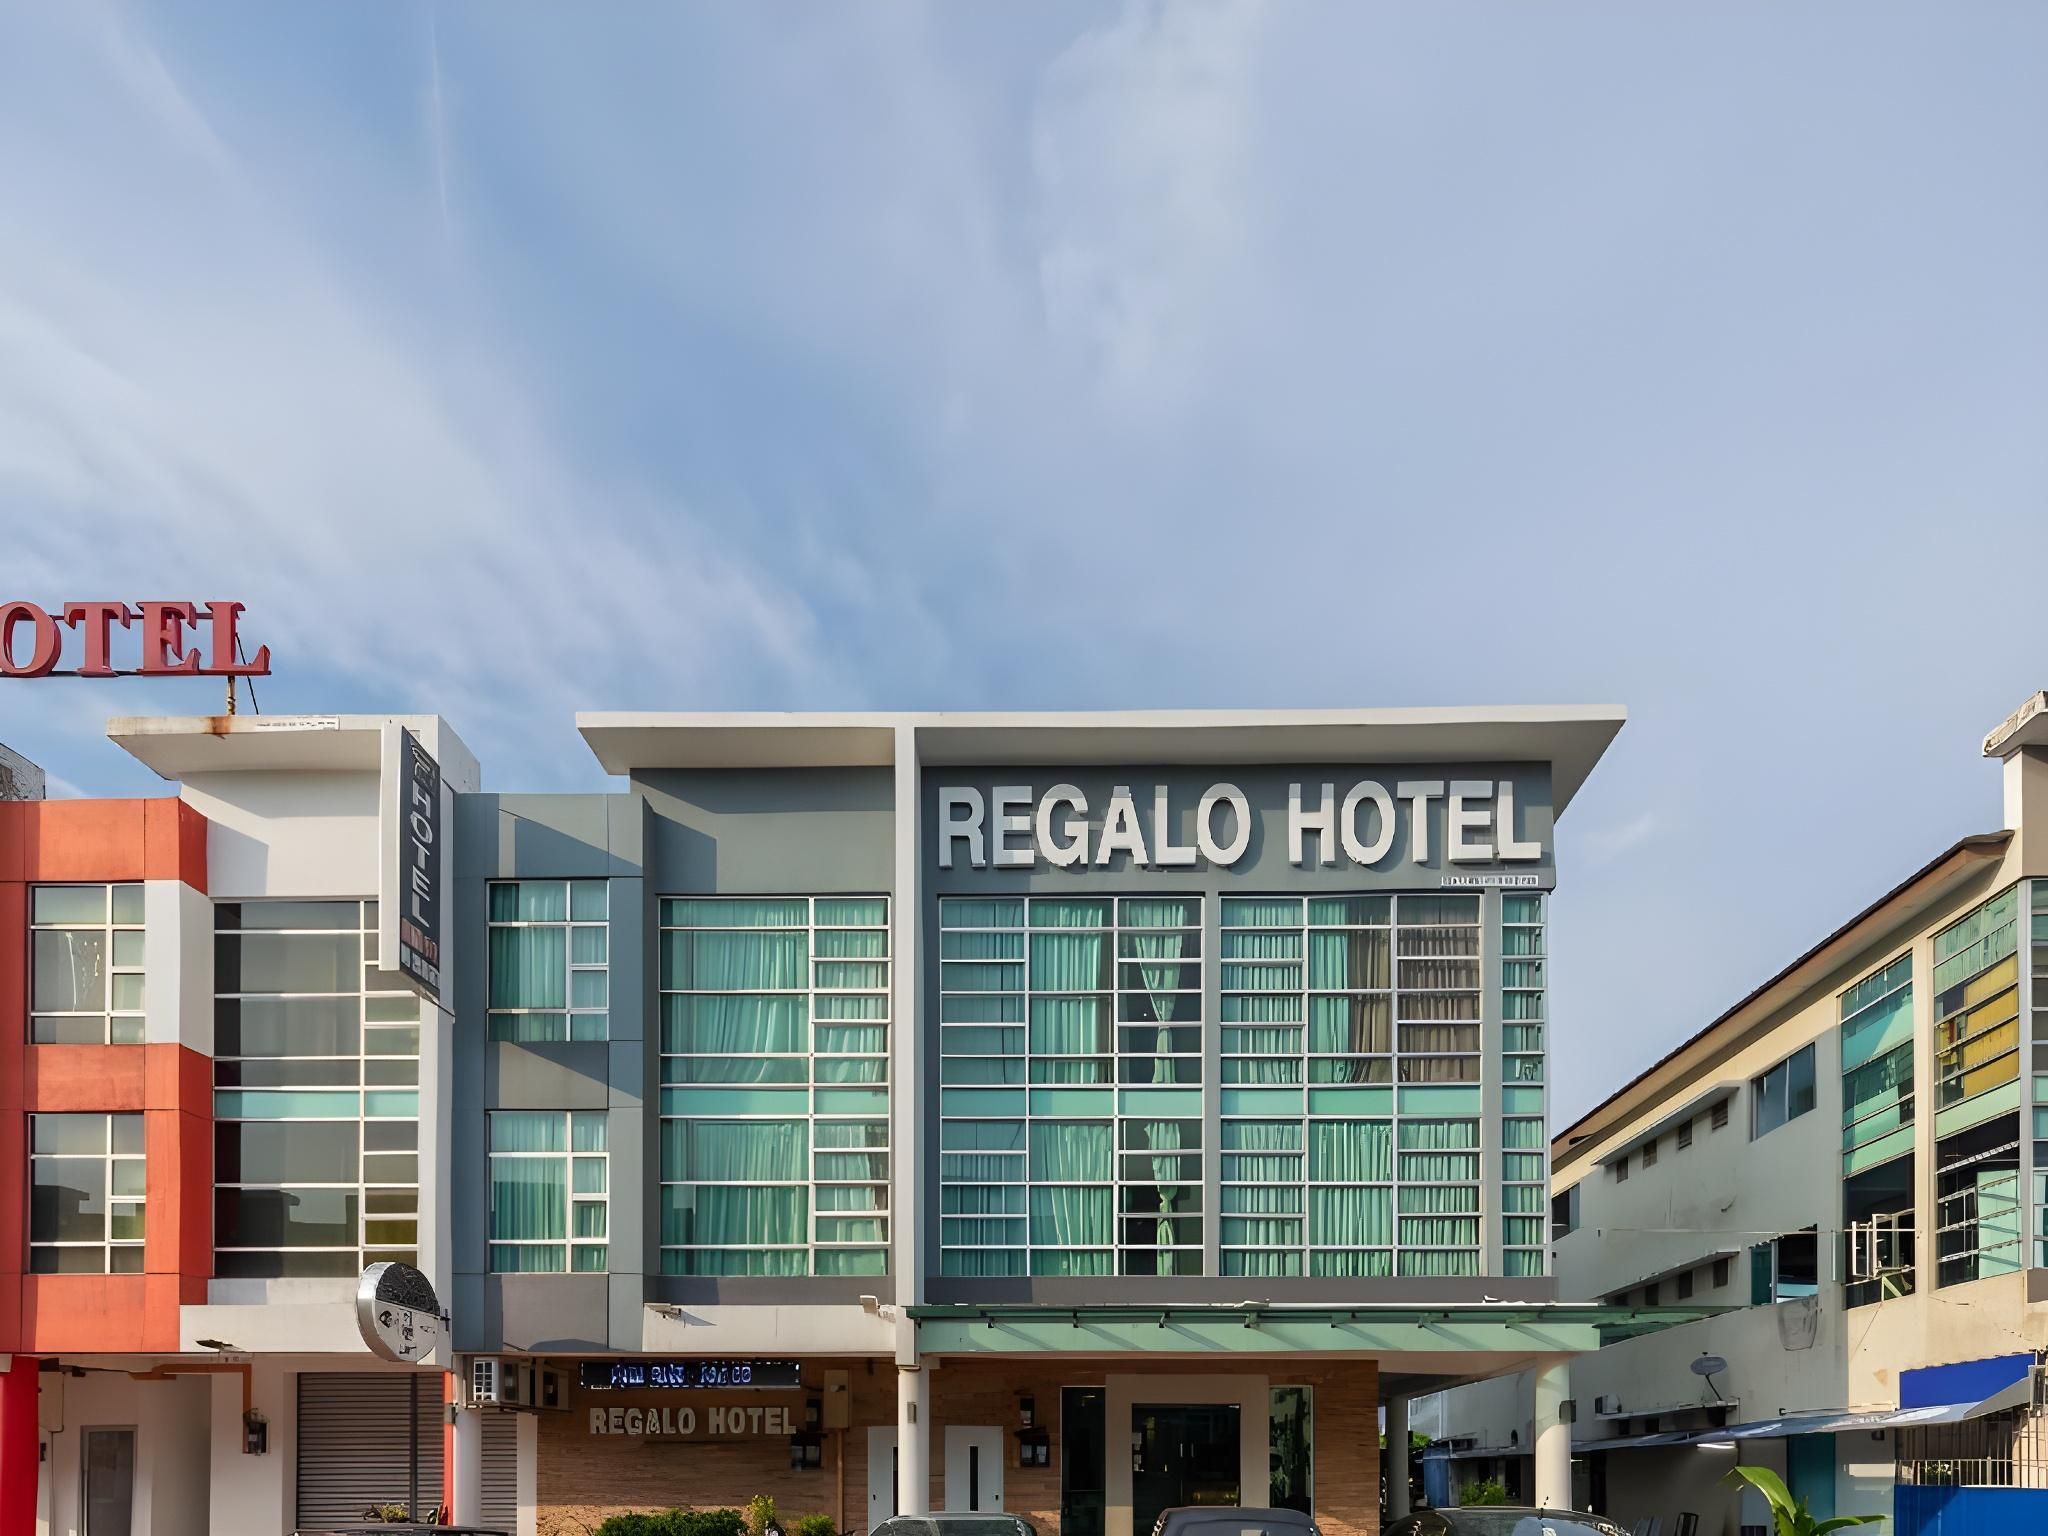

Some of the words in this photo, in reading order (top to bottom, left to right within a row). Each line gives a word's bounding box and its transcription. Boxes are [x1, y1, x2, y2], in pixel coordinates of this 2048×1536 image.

[0, 601, 271, 676] OTEL
[410, 779, 433, 928] HOTEL
[938, 783, 1251, 867] REGALO
[1288, 780, 1542, 865] HOTEL
[589, 1407, 696, 1435] REGALO
[708, 1407, 797, 1435] HOTEL
